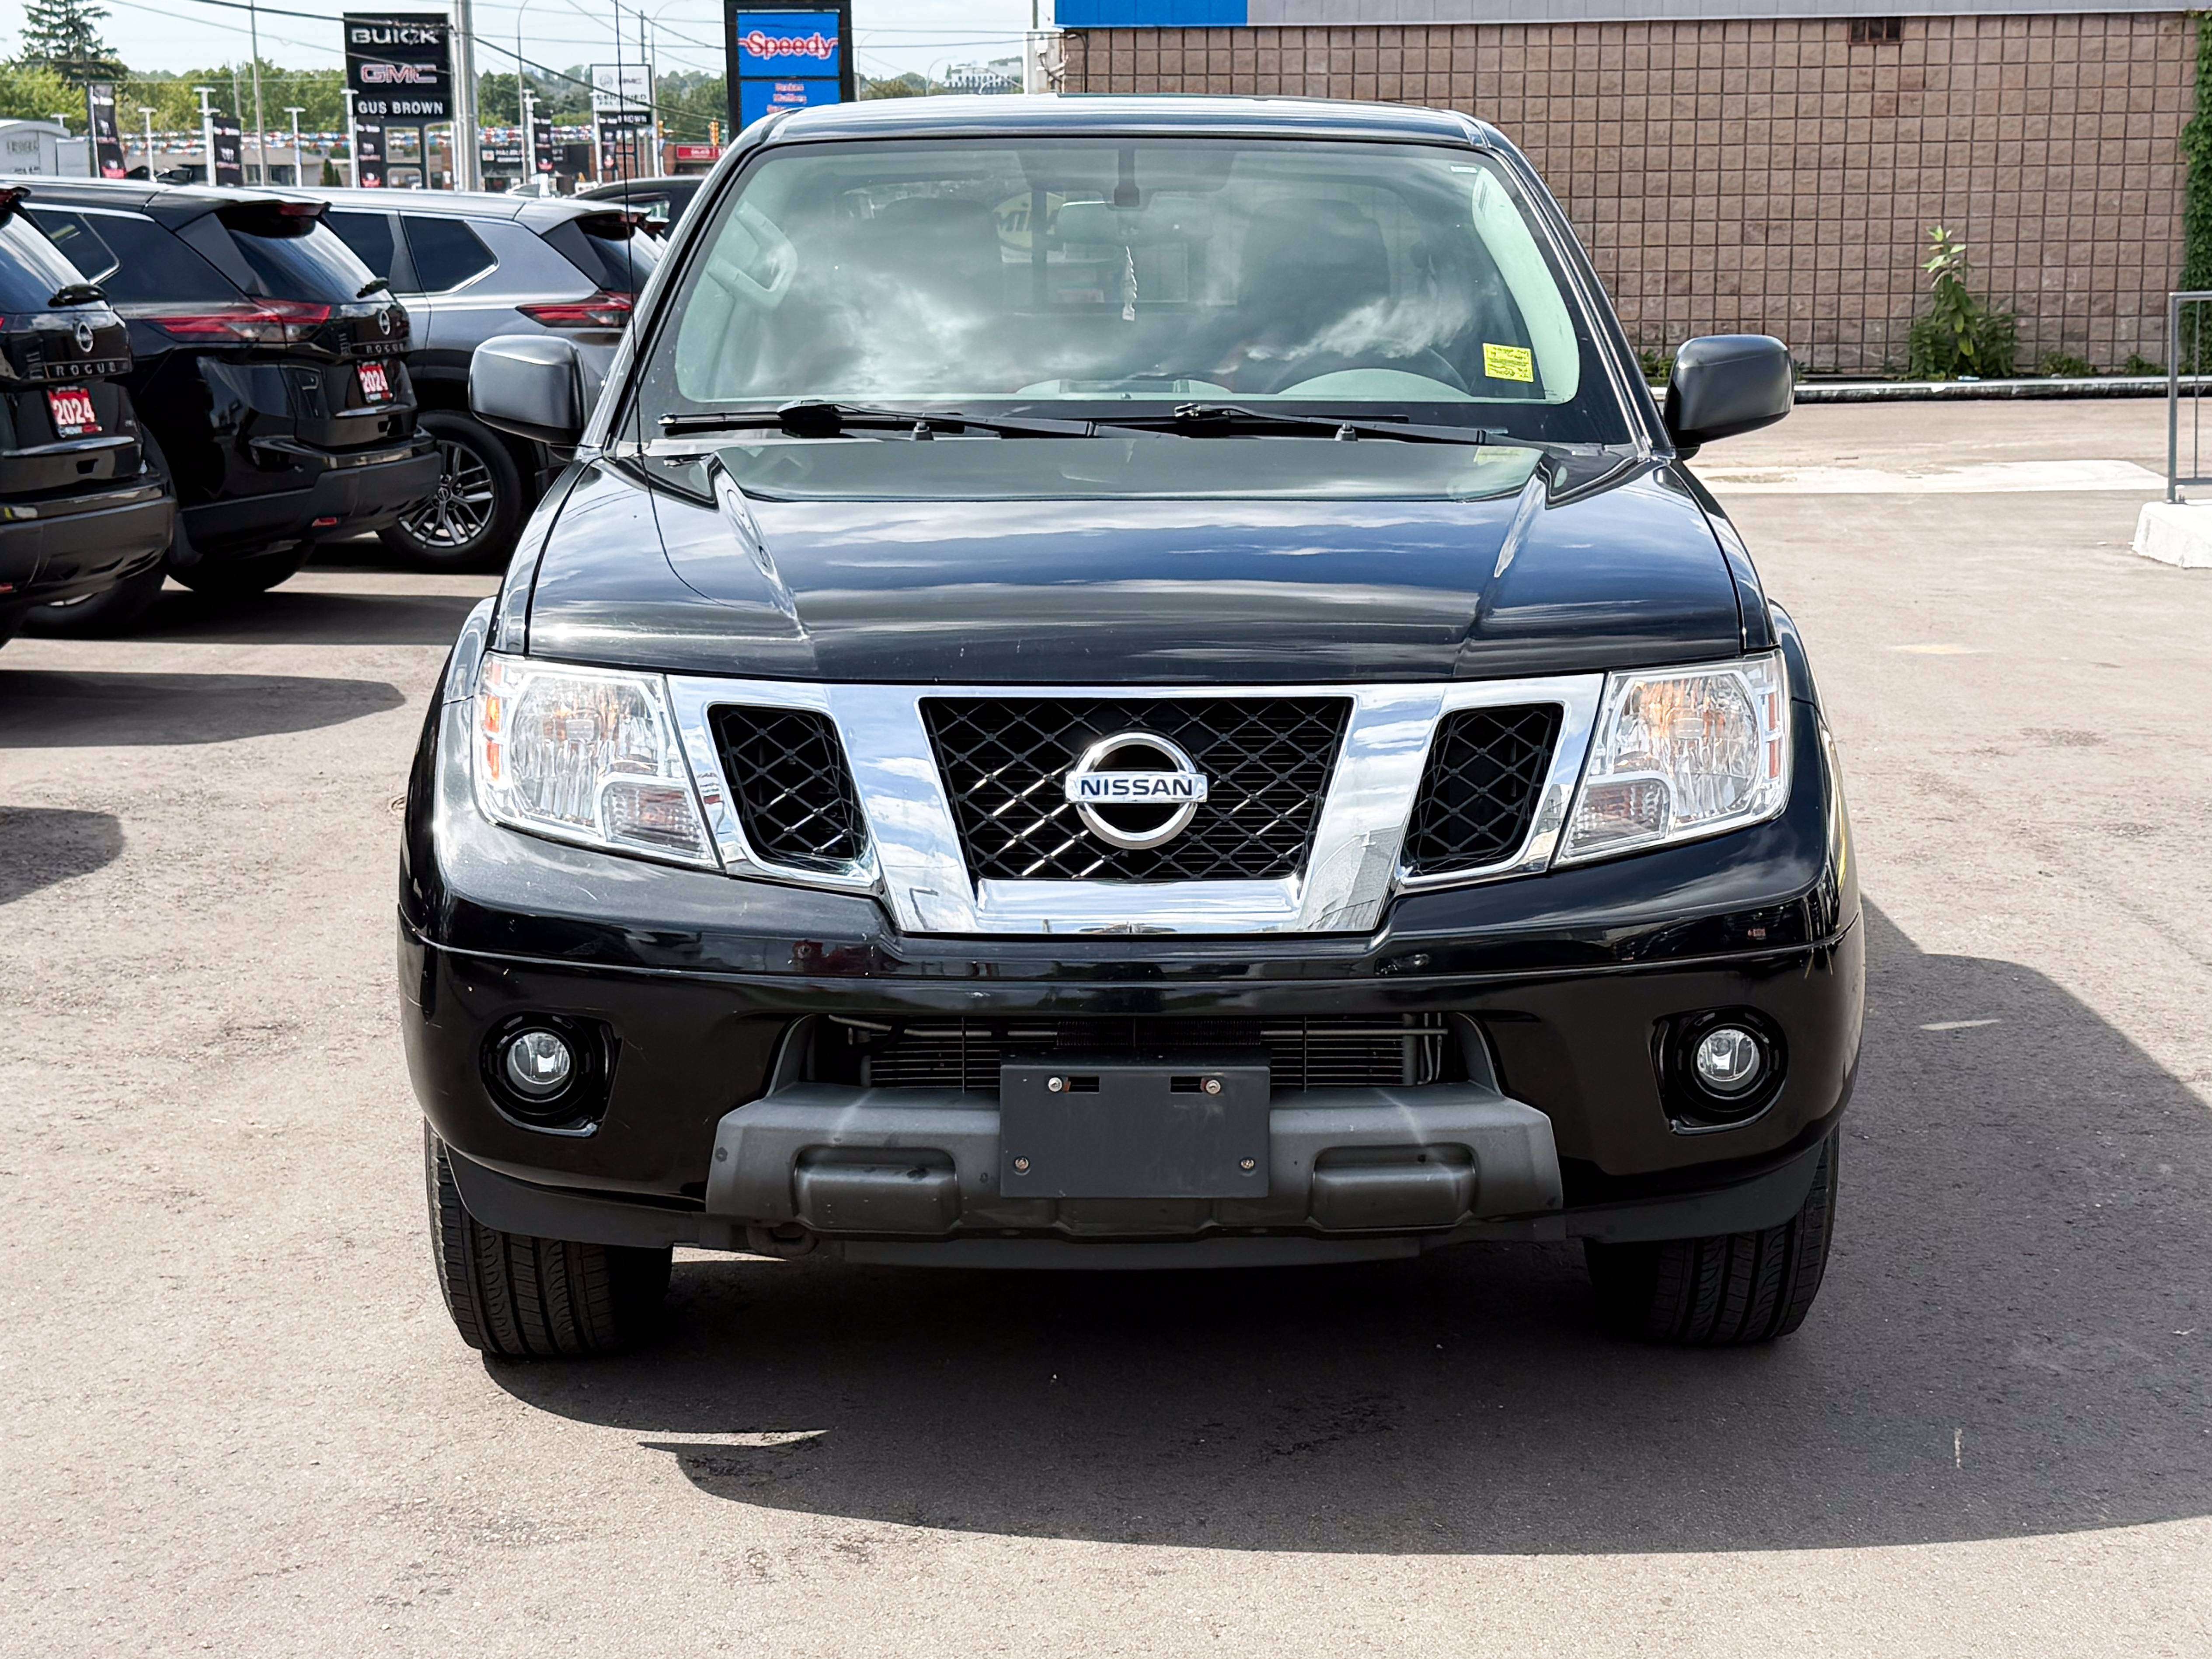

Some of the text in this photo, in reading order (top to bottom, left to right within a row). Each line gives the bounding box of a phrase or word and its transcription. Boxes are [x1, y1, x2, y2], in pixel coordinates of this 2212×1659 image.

[352, 29, 439, 44] BUICK
[738, 31, 838, 60] Speedy
[361, 64, 437, 83] GMC
[358, 101, 443, 115] GUS BROWN
[56, 362, 116, 376] ROGUE
[359, 369, 388, 393] 2024
[52, 397, 95, 425] 2024
[1081, 779, 1192, 796] NISSAN
